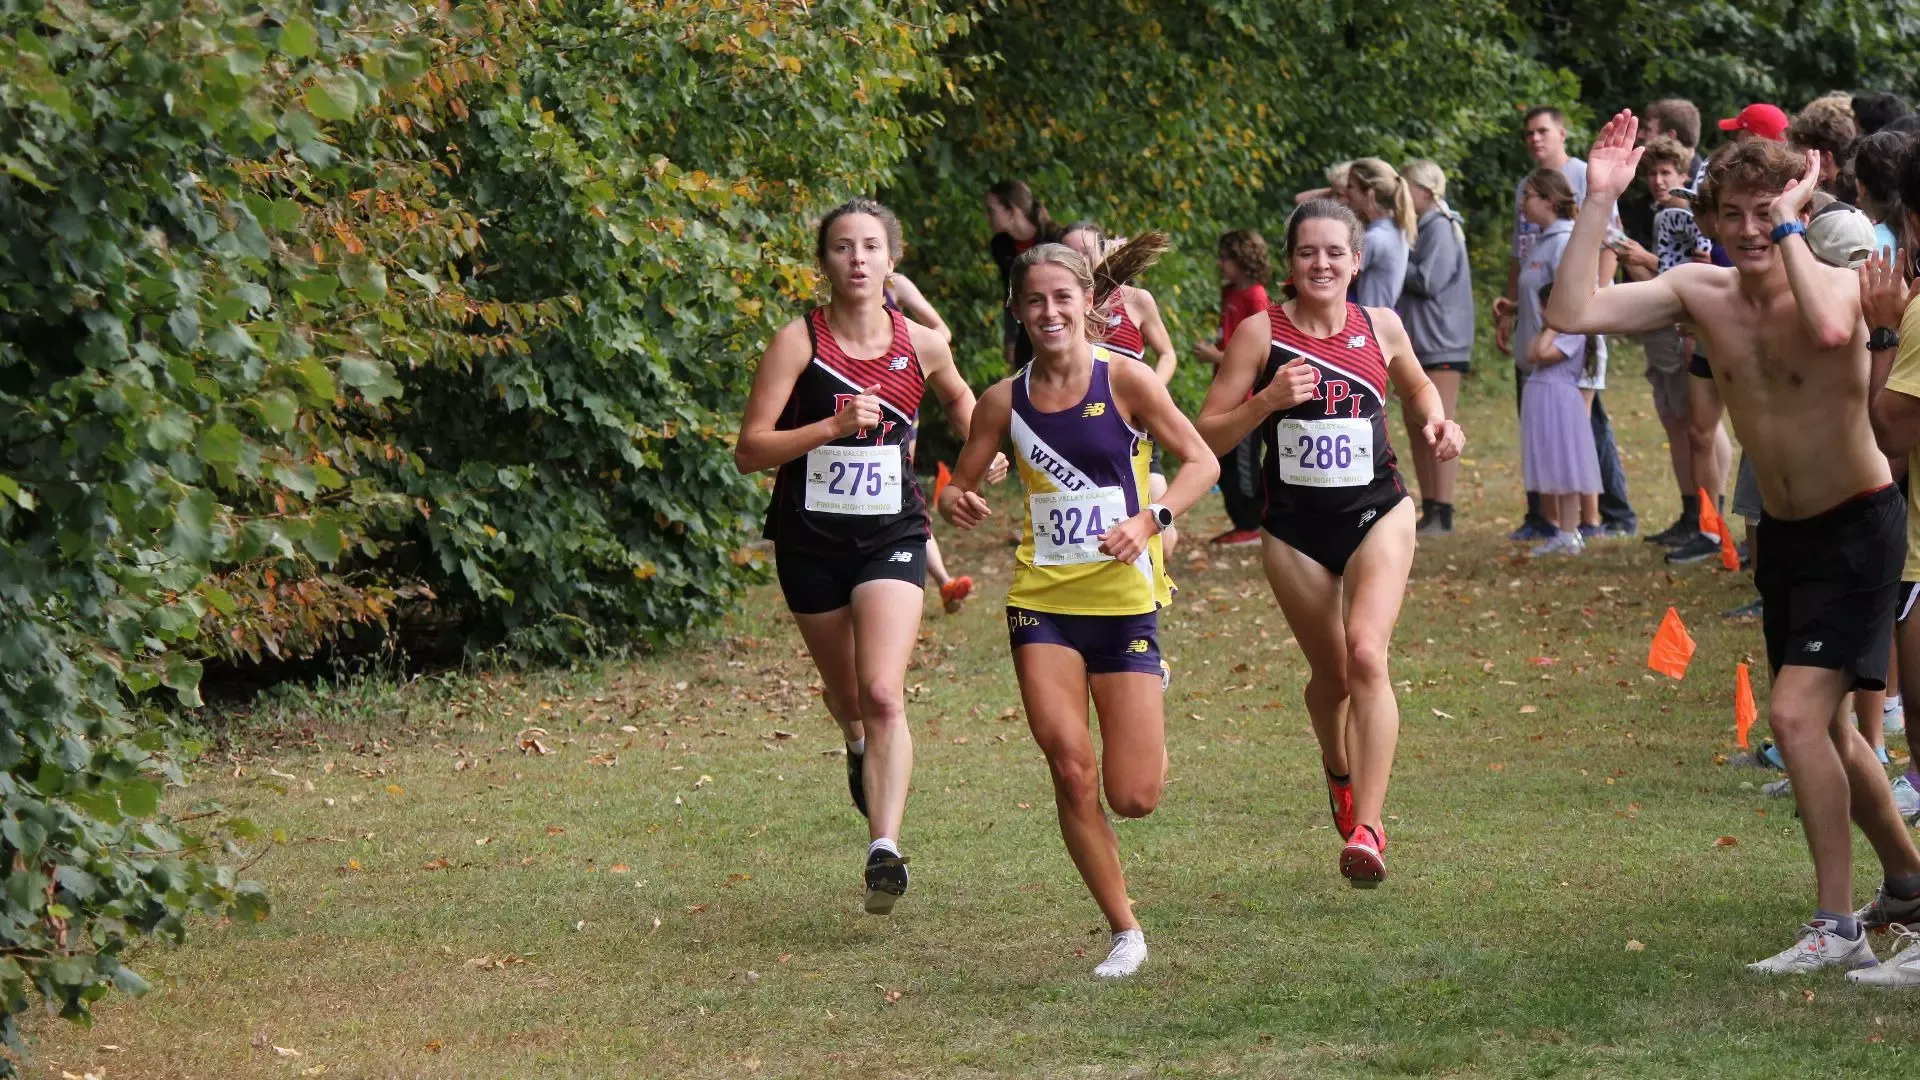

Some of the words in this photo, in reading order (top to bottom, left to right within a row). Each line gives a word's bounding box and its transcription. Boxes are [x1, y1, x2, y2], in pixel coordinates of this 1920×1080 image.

[814, 449, 842, 457] PURPLE
[1298, 434, 1352, 470] 286
[828, 461, 882, 497] 275
[816, 501, 841, 510] FINISH
[841, 503, 865, 511] RIGHT
[1049, 505, 1106, 546] 324
